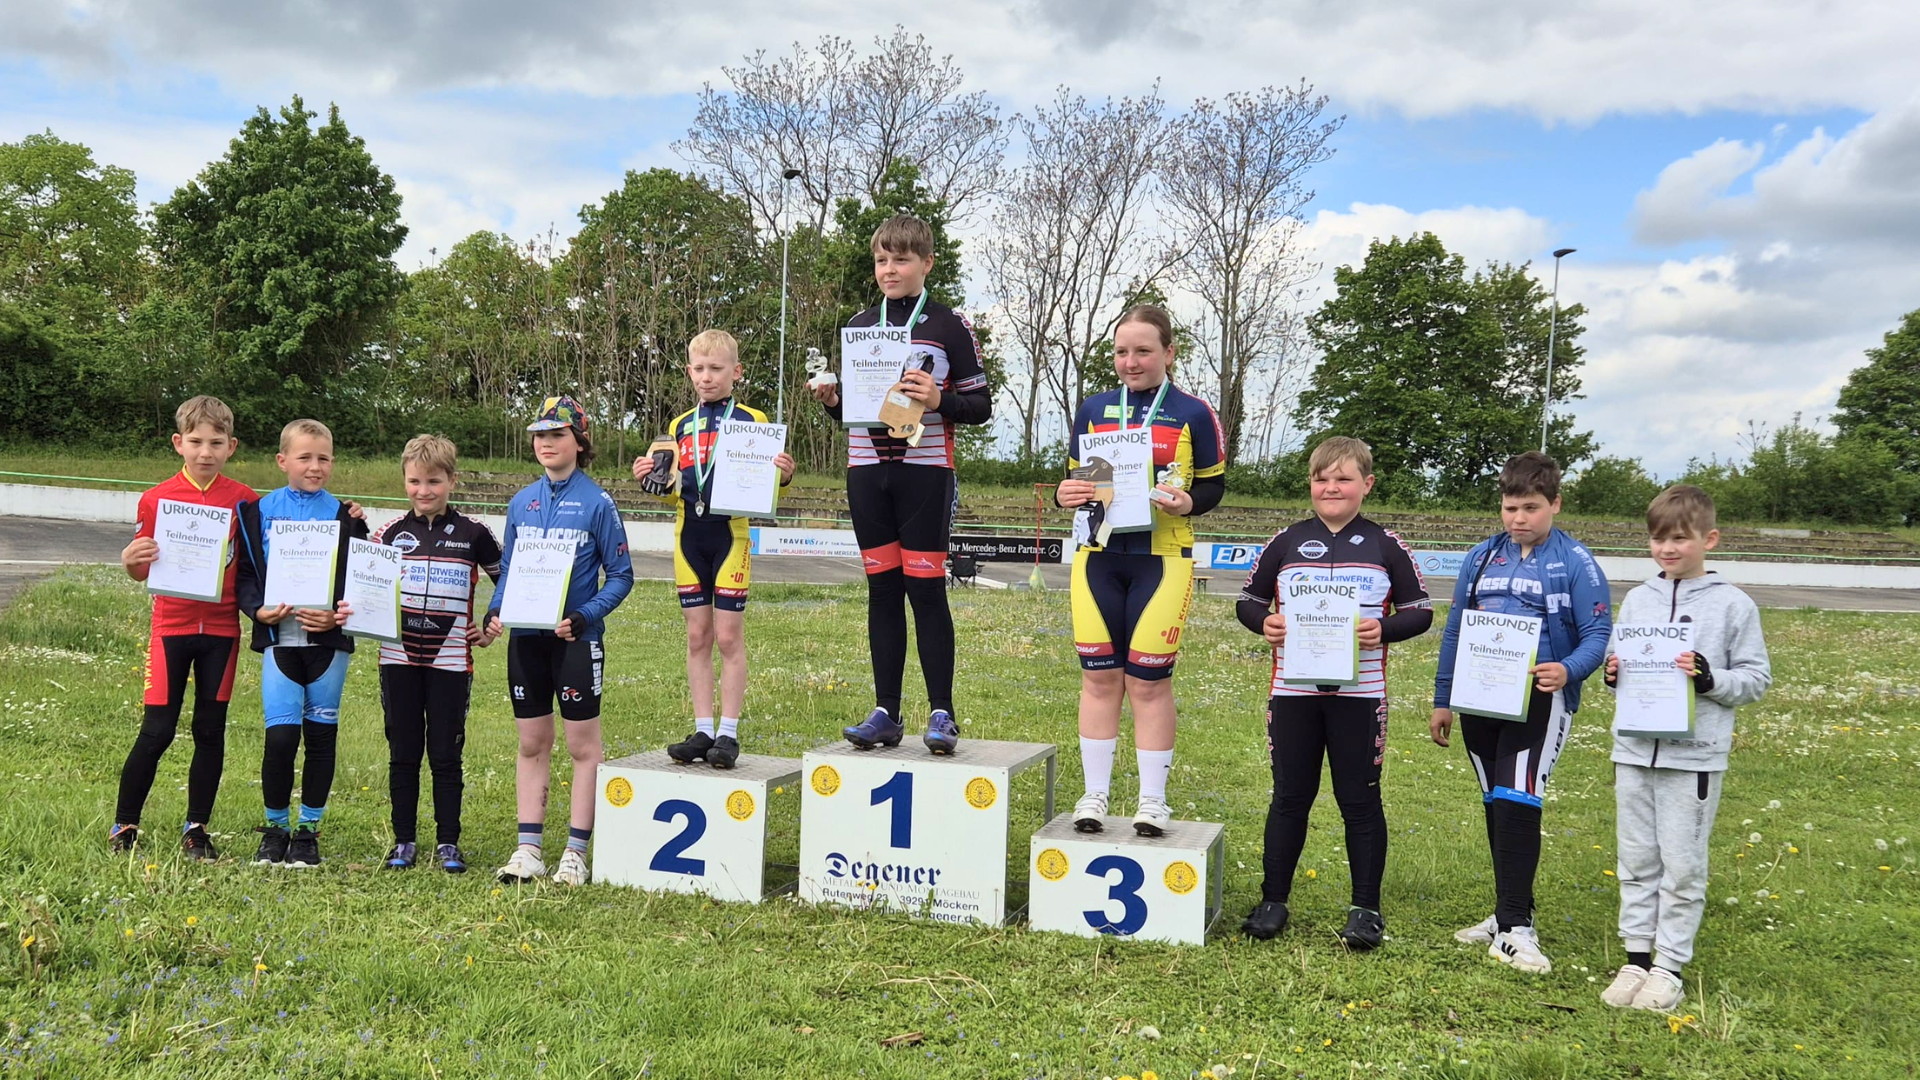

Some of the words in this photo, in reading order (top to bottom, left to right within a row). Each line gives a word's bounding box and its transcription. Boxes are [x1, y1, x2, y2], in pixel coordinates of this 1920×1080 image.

[845, 331, 908, 344] URKUNDE
[851, 359, 902, 368] Teilnehmer
[724, 424, 783, 441] URKUNDE
[1083, 432, 1148, 450] URKUNDE
[726, 450, 774, 462] Teilnehmer
[163, 503, 229, 525] URKUNDE
[165, 529, 218, 545] Teilnehmer
[275, 523, 336, 536] URKUNDE
[445, 540, 471, 549] Nemak
[517, 542, 573, 555] URKUNDE
[949, 542, 960, 552] Ihr
[961, 542, 1017, 553] Mercedes-Benz
[279, 548, 328, 557] Teilnehmer
[351, 541, 399, 564] URKUNDE
[352, 569, 392, 585] Teilnehmer
[410, 565, 469, 580] STADTWERKE
[517, 566, 562, 575] Teilnehmer
[409, 574, 468, 588] WERNIGERODE
[1289, 584, 1357, 600] URKUNDE
[1294, 613, 1350, 623] Teilnehmer
[1466, 614, 1538, 636] URKUNDE
[1616, 627, 1689, 642] URKUNDE
[1468, 642, 1526, 659] Teilnehmer
[1622, 658, 1677, 669] Teilnehme
[870, 771, 914, 849] 1
[649, 799, 707, 877] 2
[825, 852, 942, 886] Degener
[881, 882, 904, 891] UND
[823, 887, 873, 903] Rutenweg
[932, 898, 979, 911] Möckern
[1082, 855, 1148, 936] 3
